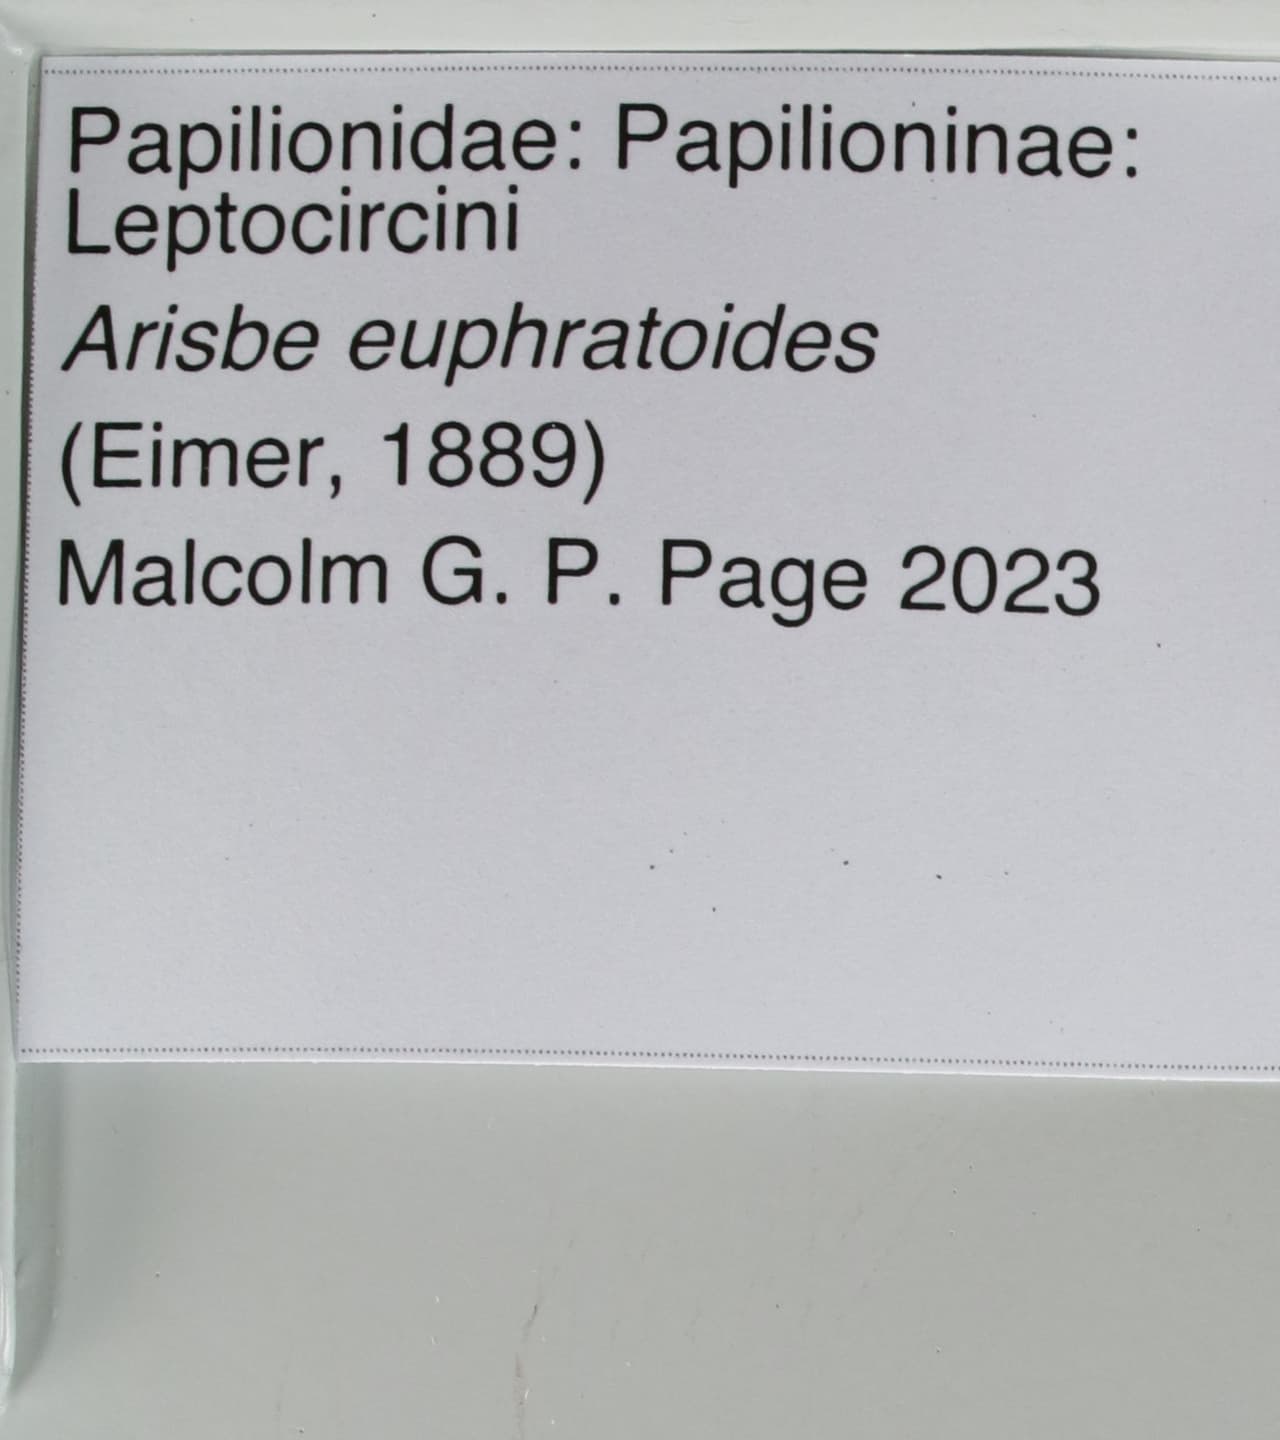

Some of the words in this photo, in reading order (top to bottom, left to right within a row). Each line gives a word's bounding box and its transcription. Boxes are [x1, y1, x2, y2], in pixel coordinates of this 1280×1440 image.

[69, 102, 582, 189] Papilionidae:
[617, 102, 1138, 190] Papilioninae:
[67, 189, 519, 271] Leptocircini
[59, 302, 320, 373] Arisbe
[348, 300, 880, 385] euphratoides
[60, 420, 342, 506] (Eimer,
[383, 418, 605, 506] 1889)
[58, 536, 388, 608] Malcolm
[421, 534, 508, 607] G.
[546, 536, 621, 607] P.
[661, 538, 868, 629] Page
[899, 544, 1101, 618] 2023
